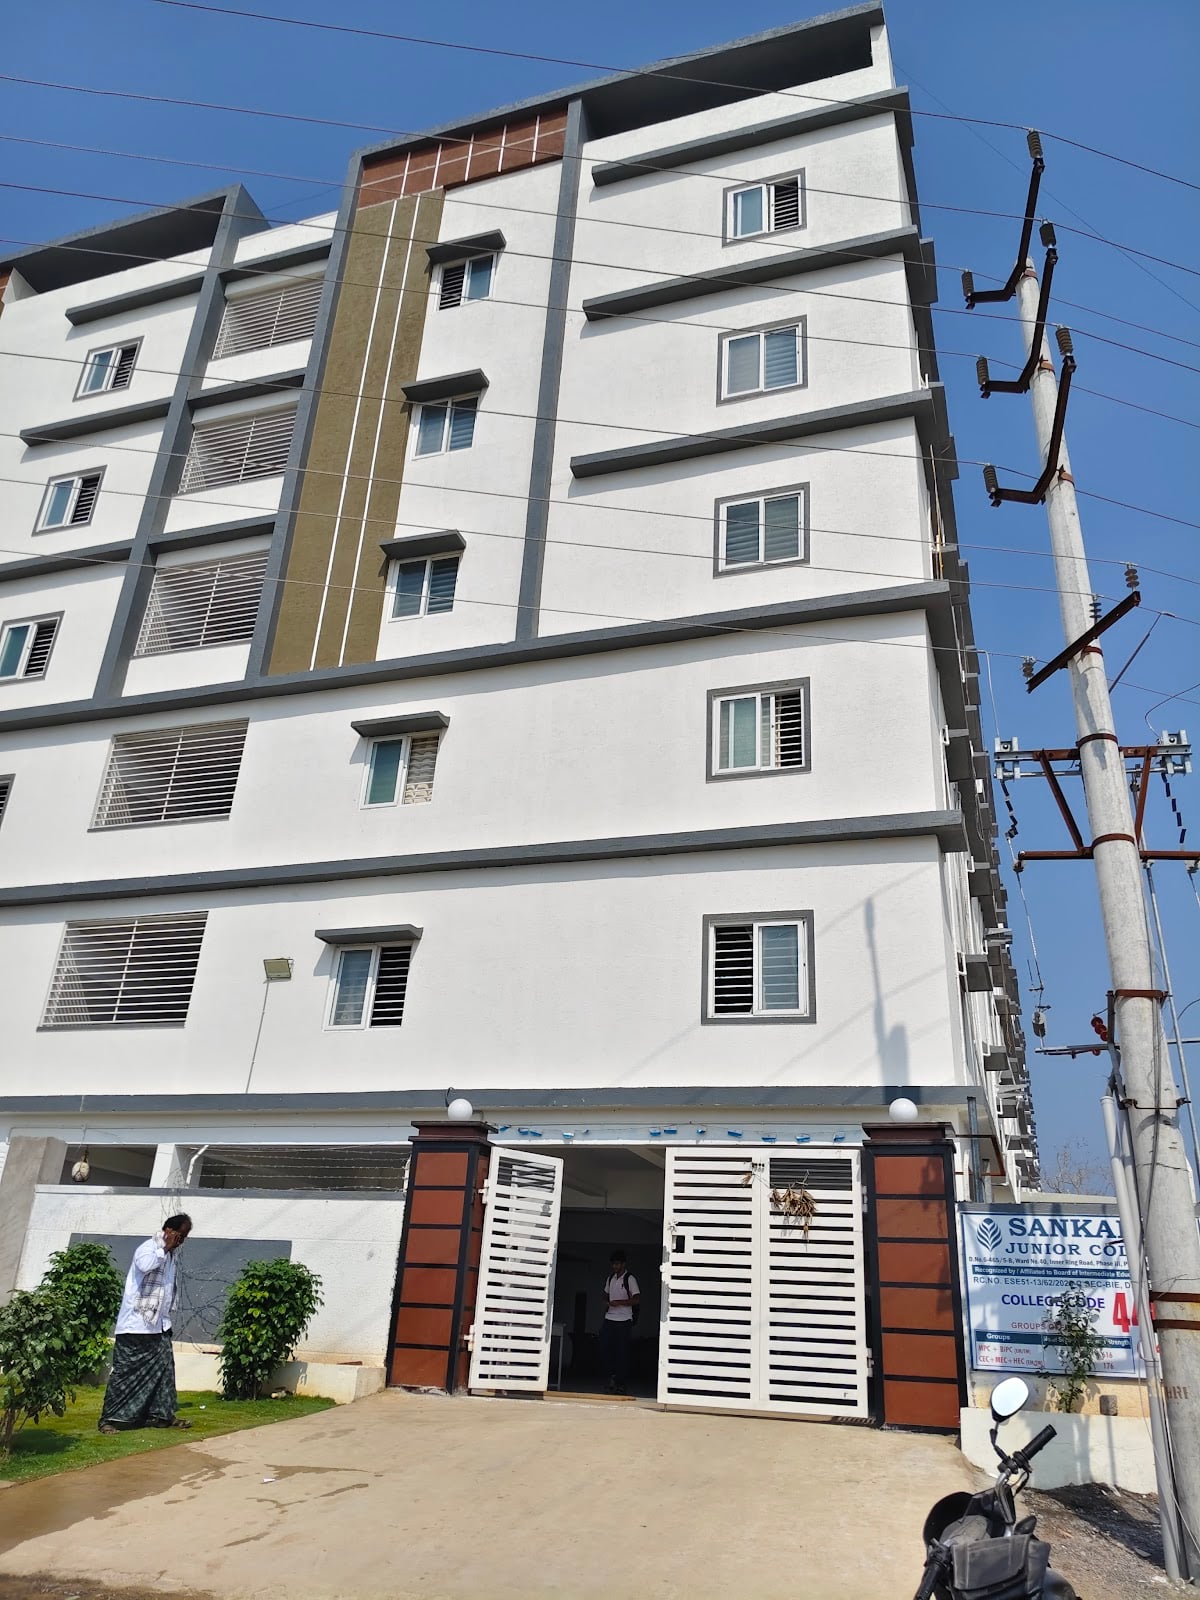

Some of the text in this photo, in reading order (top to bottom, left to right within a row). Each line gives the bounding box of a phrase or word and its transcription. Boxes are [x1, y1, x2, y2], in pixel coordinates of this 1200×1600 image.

[1009, 1217, 1122, 1239] SANKA
[1005, 1242, 1081, 1256] JUNIOR
[974, 1267, 1008, 1275] Recognized
[1020, 1268, 1046, 1276] Affiliated
[1079, 1270, 1116, 1278] Intermediate
[1011, 1321, 1046, 1331] GROUPS
[986, 1332, 1011, 1342] Groups
